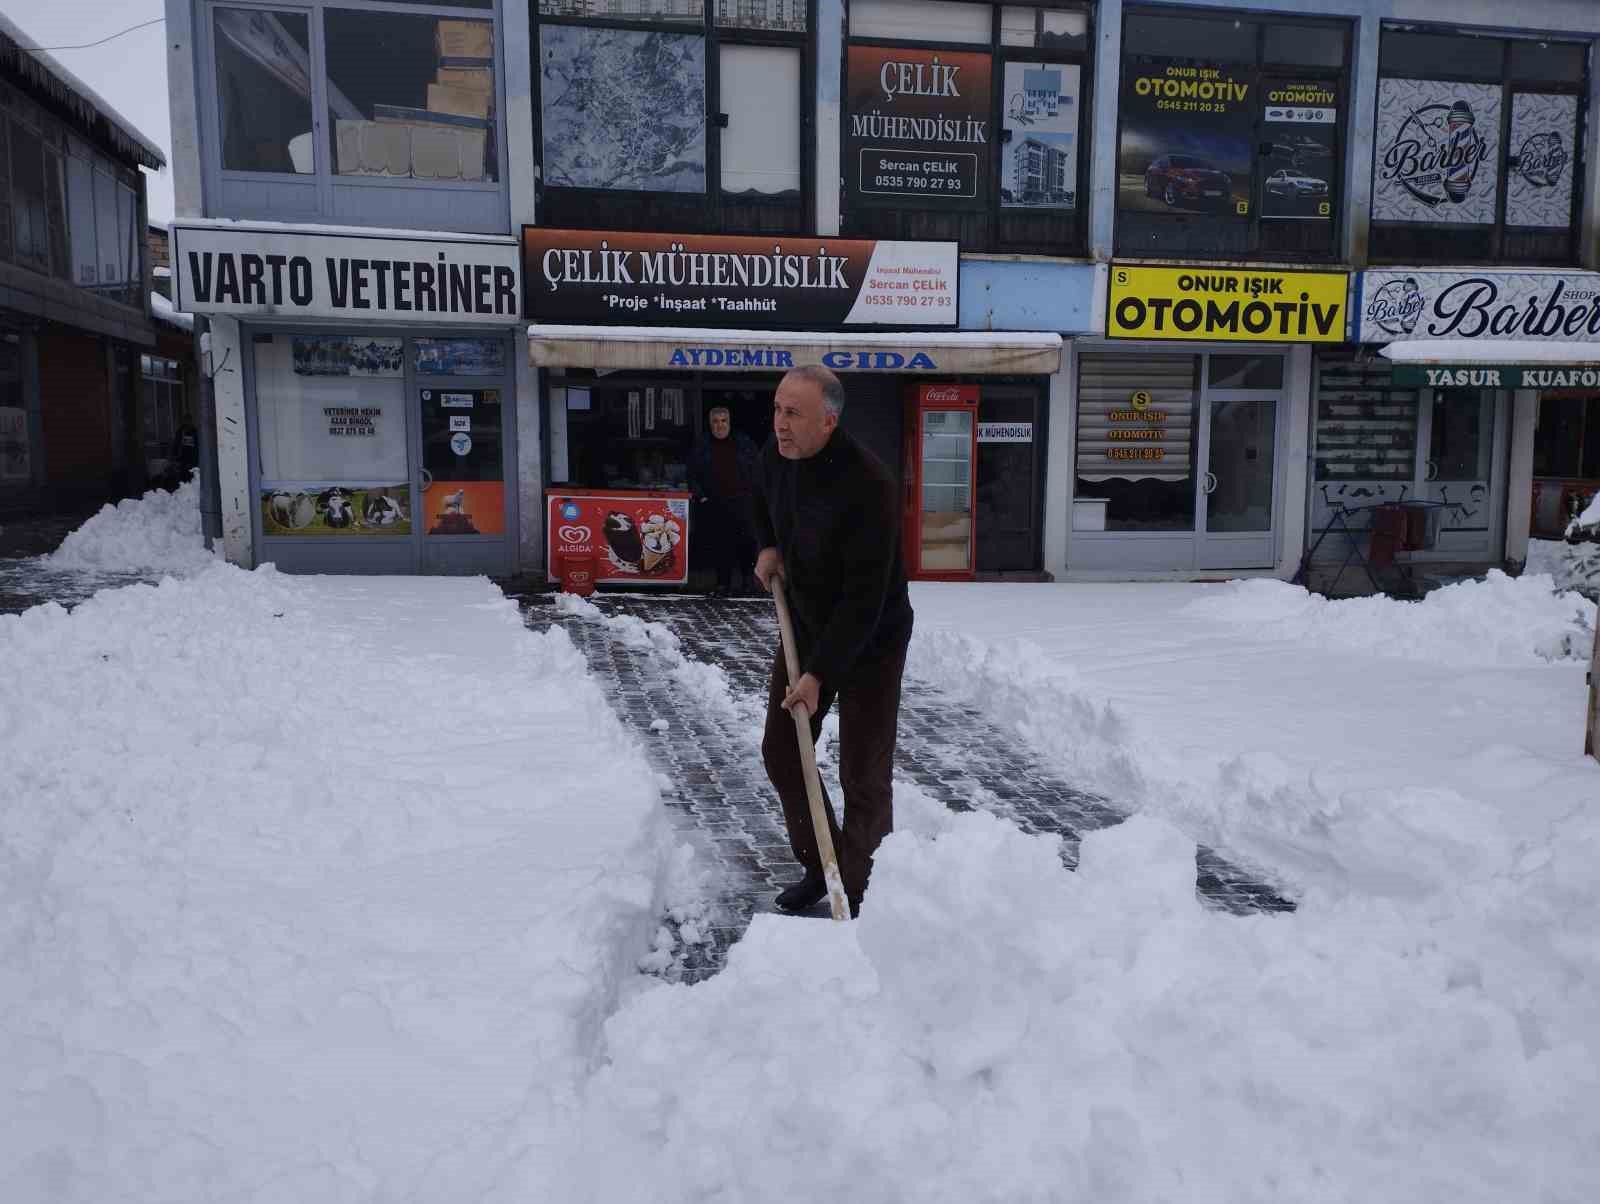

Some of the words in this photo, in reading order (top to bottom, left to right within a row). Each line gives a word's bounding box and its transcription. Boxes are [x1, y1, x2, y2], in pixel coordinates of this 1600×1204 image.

[880, 55, 961, 101] ÇELİK
[1166, 66, 1198, 77] ONUR
[1135, 78, 1248, 101] OTOMOTİV
[1269, 89, 1335, 103] OTOMOTİV
[1157, 100, 1181, 109] 0545
[1183, 101, 1198, 111] 211
[1199, 102, 1212, 111] 20
[1214, 103, 1225, 112] 25
[851, 110, 987, 143] MÜHENDİSLİK
[1383, 130, 1490, 179] Barber
[1519, 148, 1568, 172] Barber
[879, 159, 919, 171] Sercan
[923, 159, 958, 174] ÇELİK
[875, 175, 903, 187] 0535
[906, 177, 927, 188] 790
[930, 177, 945, 188] 27
[947, 178, 961, 189] 93
[542, 240, 634, 290] ÇELİK
[639, 243, 850, 289] MÜHENDİSLİK
[188, 252, 313, 306] VARTO
[325, 252, 516, 315] VETERİNER
[869, 279, 909, 289] Sercan
[912, 278, 947, 292] ÇELİK
[1116, 271, 1128, 283] S
[1178, 275, 1238, 293] ONUR
[1243, 277, 1284, 298] IŞIK
[865, 295, 893, 305] 0535
[896, 296, 917, 306] 790
[920, 296, 934, 306] 27
[937, 296, 951, 306] 93
[1562, 290, 1597, 300] SHOP
[1115, 292, 1340, 335] OTOMOTİV
[1366, 293, 1425, 321] Barber
[668, 346, 794, 368] AYDEMİR
[822, 351, 938, 369] GIDA
[1426, 369, 1501, 386] YASUR
[1522, 367, 1600, 387] KUAFÖ
[1136, 392, 1147, 405] S
[559, 545, 592, 553] ALGIDA
